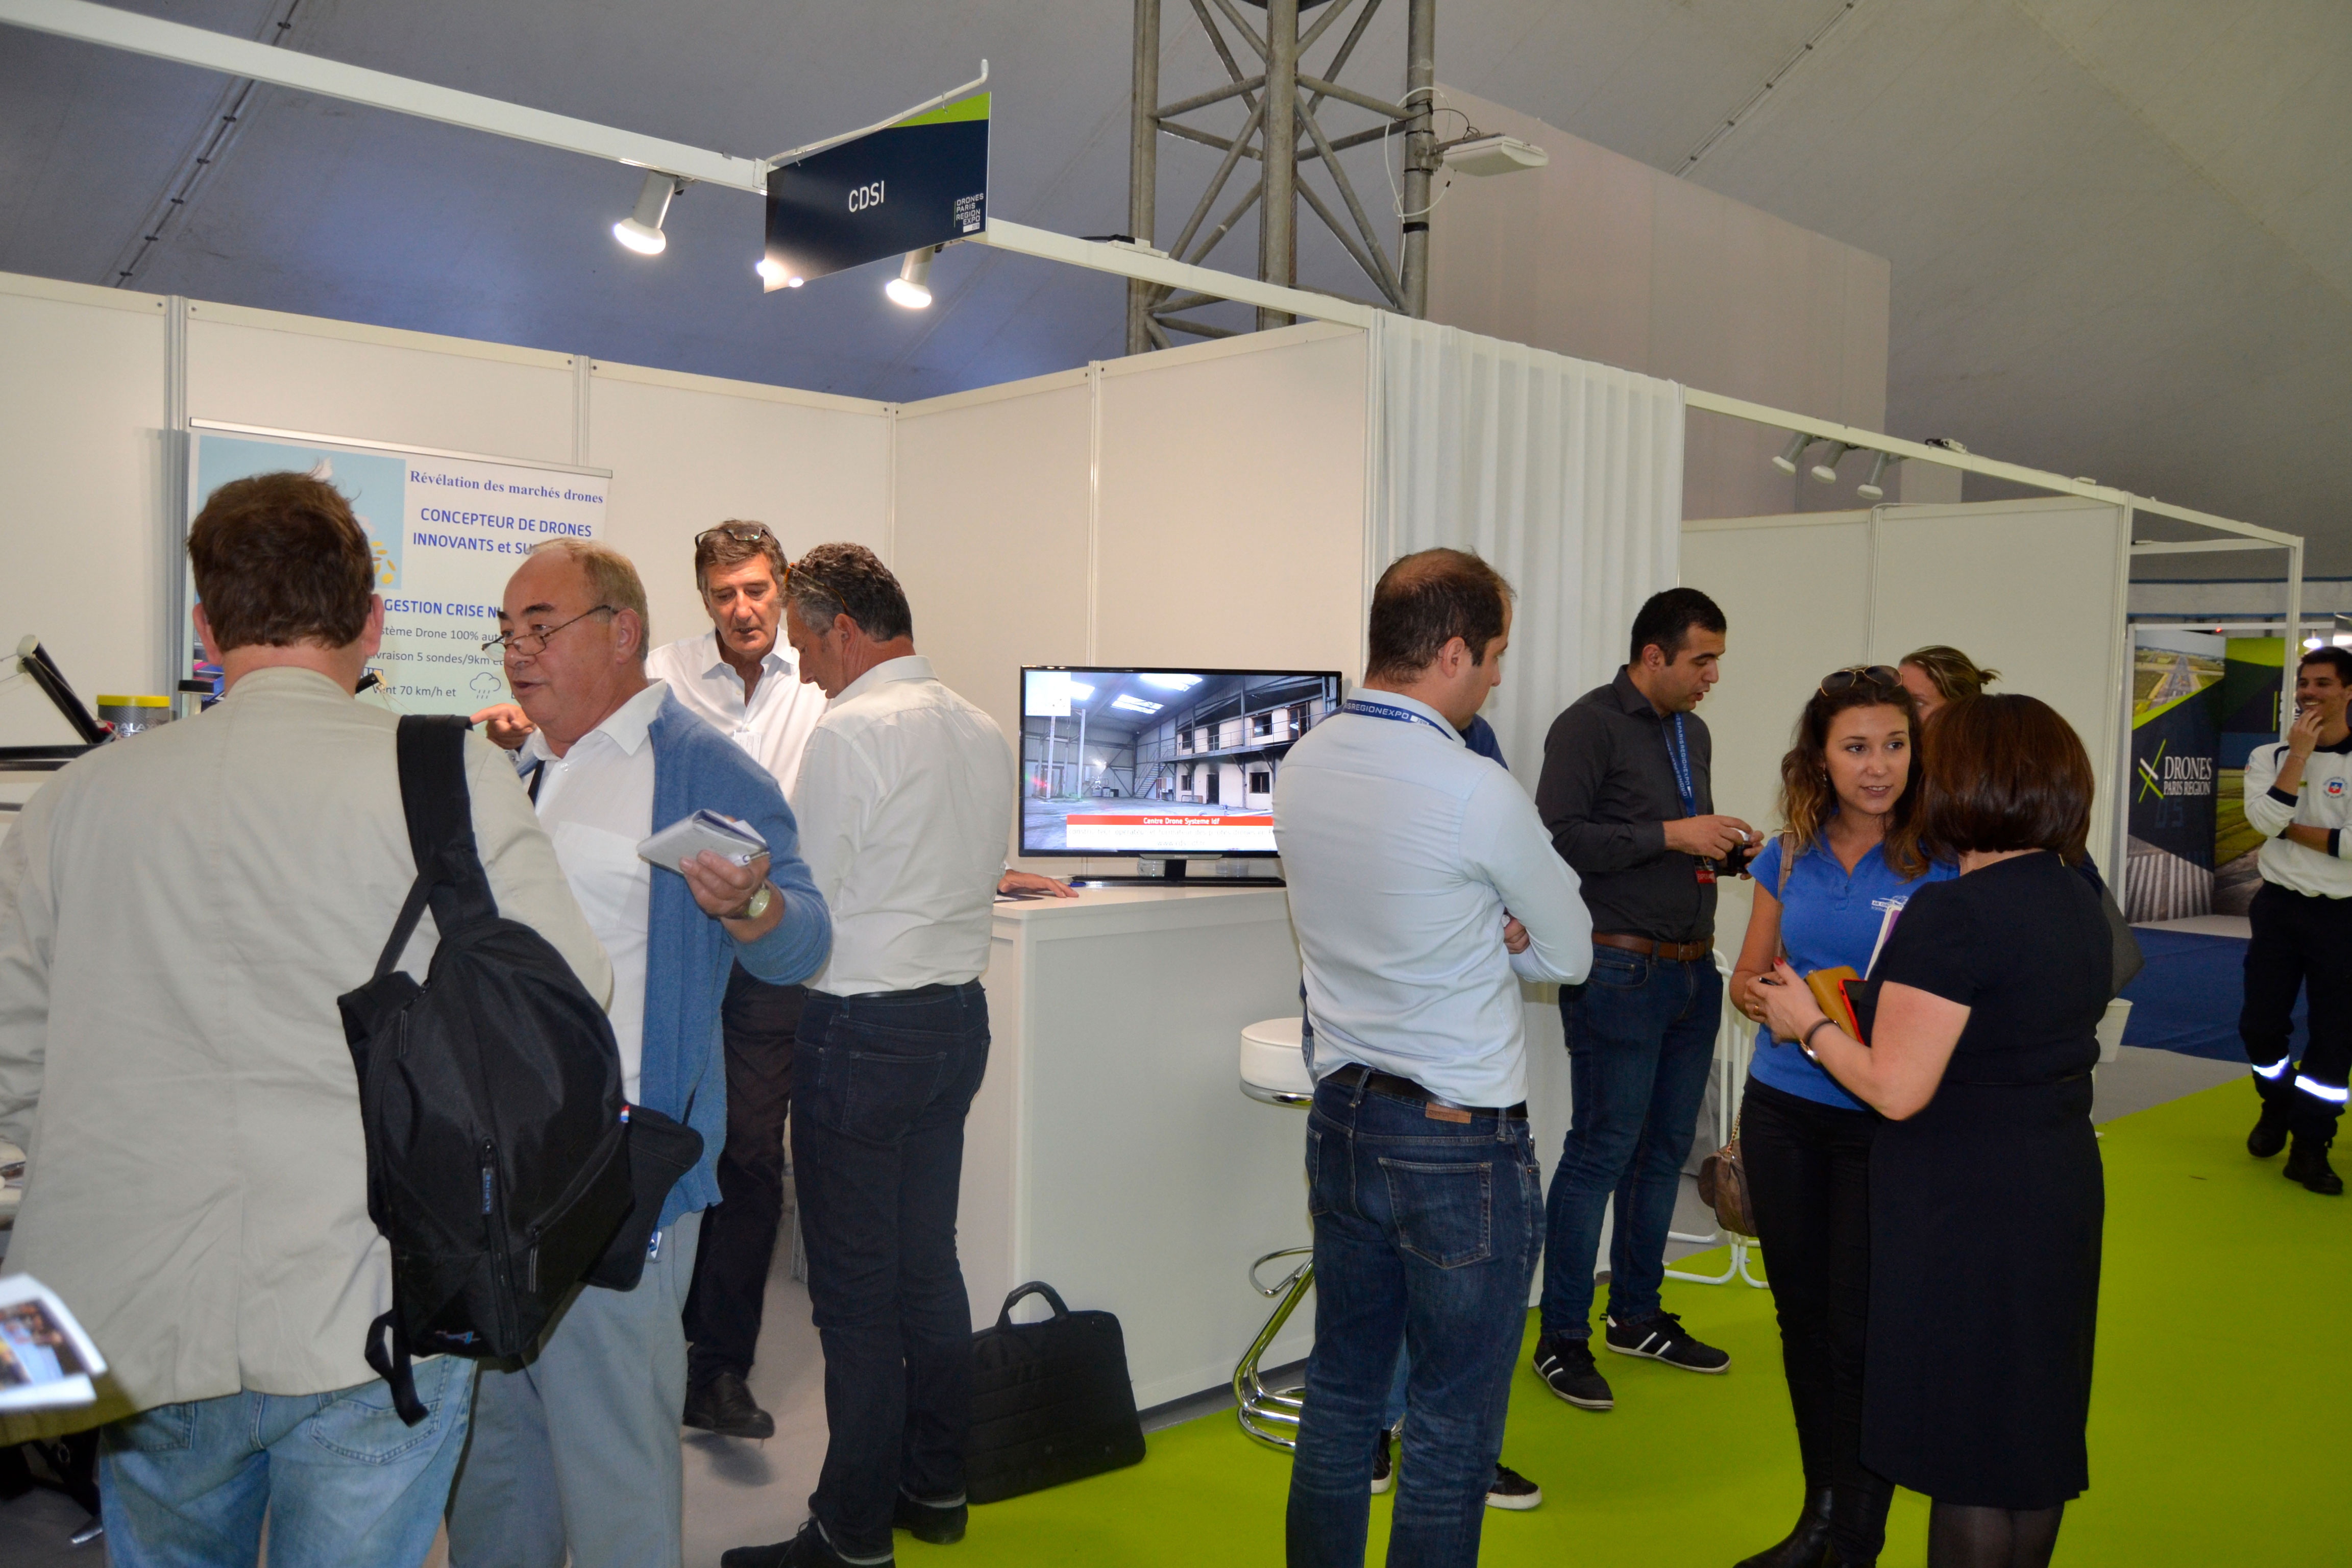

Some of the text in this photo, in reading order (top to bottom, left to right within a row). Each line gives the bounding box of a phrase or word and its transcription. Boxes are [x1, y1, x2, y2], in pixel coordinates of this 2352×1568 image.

[849, 180, 884, 212] CDSI
[957, 193, 984, 206] DRONES
[955, 208, 980, 221] REGION
[956, 202, 975, 213] PARIS
[963, 215, 980, 226] EXPO
[410, 470, 603, 504] Révélation des marchés drones
[421, 508, 592, 537] CONCEPTEUR DE DRONES
[413, 532, 532, 555] INNOVANTS et SU
[384, 599, 443, 615] GESTION
[447, 603, 484, 618] CRISE
[415, 628, 447, 639] Drone
[451, 630, 479, 641] 100%
[418, 652, 423, 661] 5
[426, 654, 489, 666] sondes/9km
[400, 686, 412, 695] 70
[416, 687, 443, 697] km/h
[446, 689, 456, 697] et
[2164, 756, 2213, 780] DRONES
[2163, 781, 2211, 796] PARIS REGION
[1185, 818, 1209, 826] Systeme
